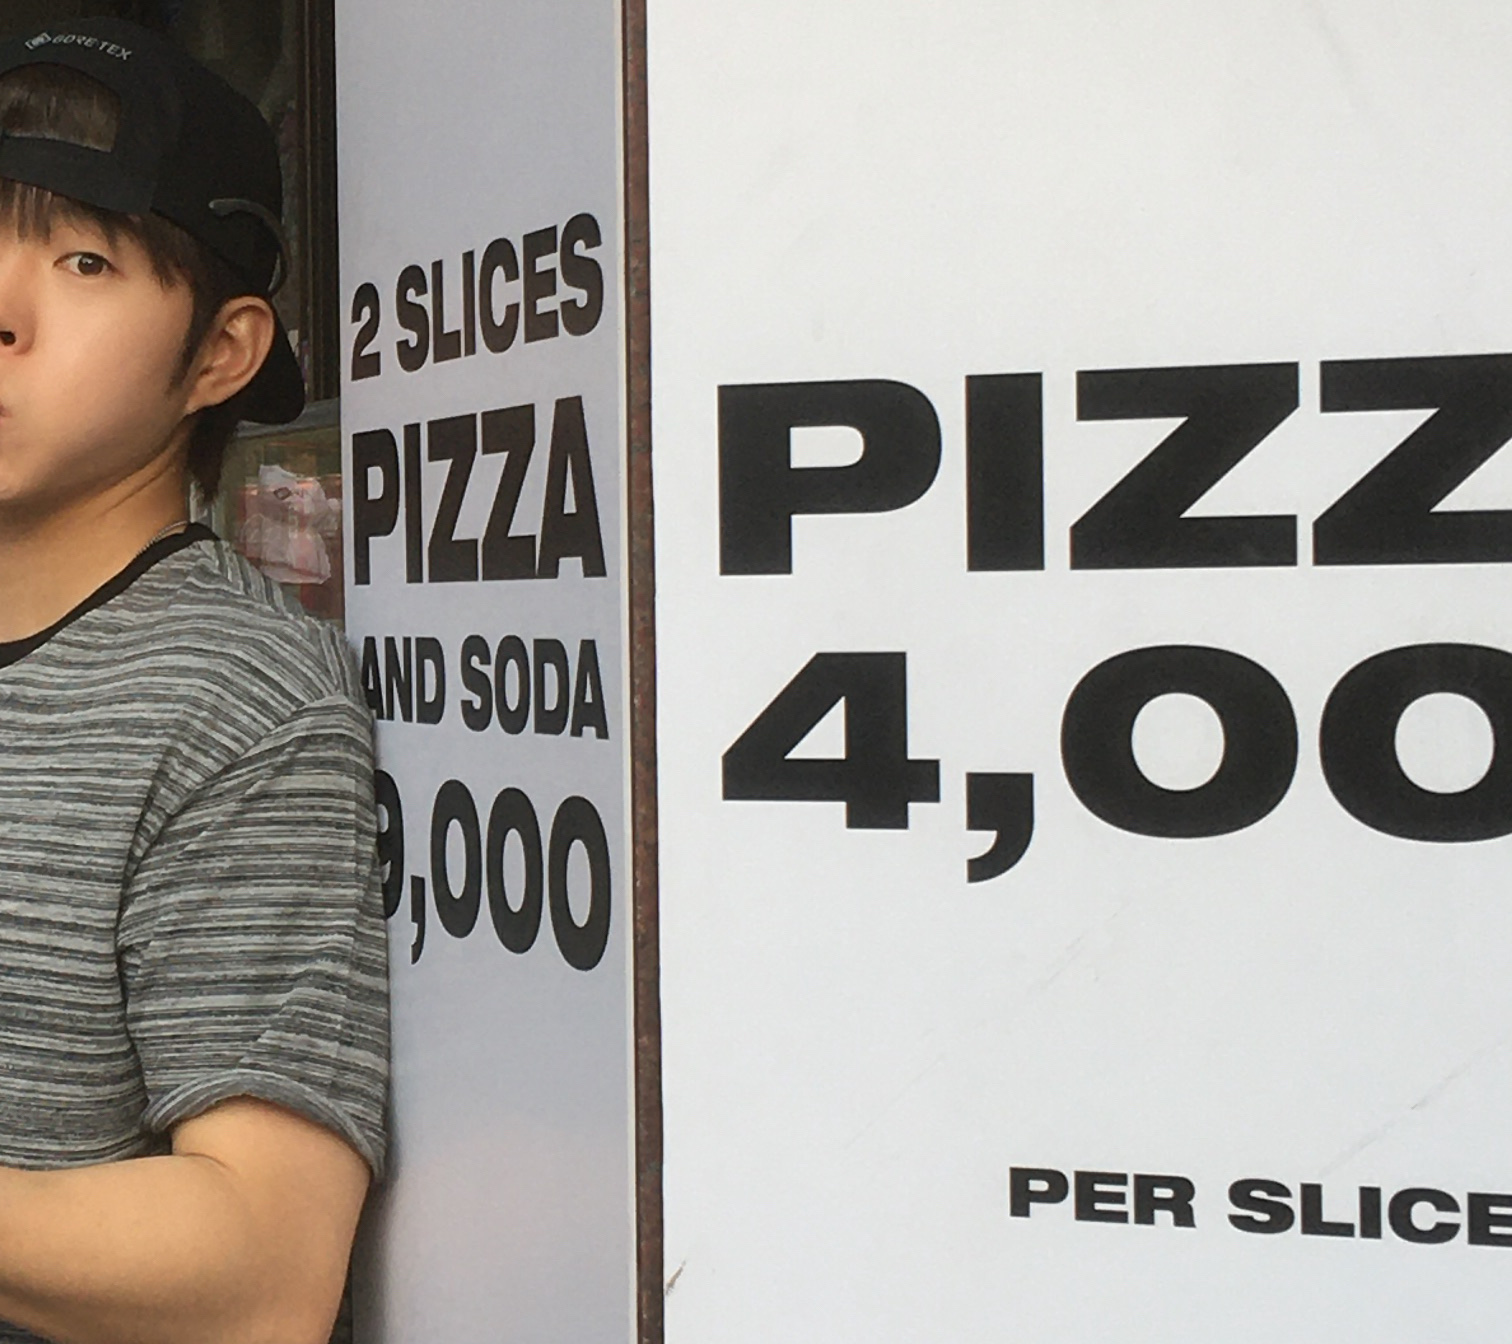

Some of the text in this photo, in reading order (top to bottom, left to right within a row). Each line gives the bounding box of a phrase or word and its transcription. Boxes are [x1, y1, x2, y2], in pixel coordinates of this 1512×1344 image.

[350, 212, 605, 383] 2 SLICES
[351, 394, 608, 587] PIZZA
[716, 352, 1512, 577] PIZZ
[360, 633, 610, 741] AND SODA
[1008, 1166, 1512, 1249] PER SLICE
